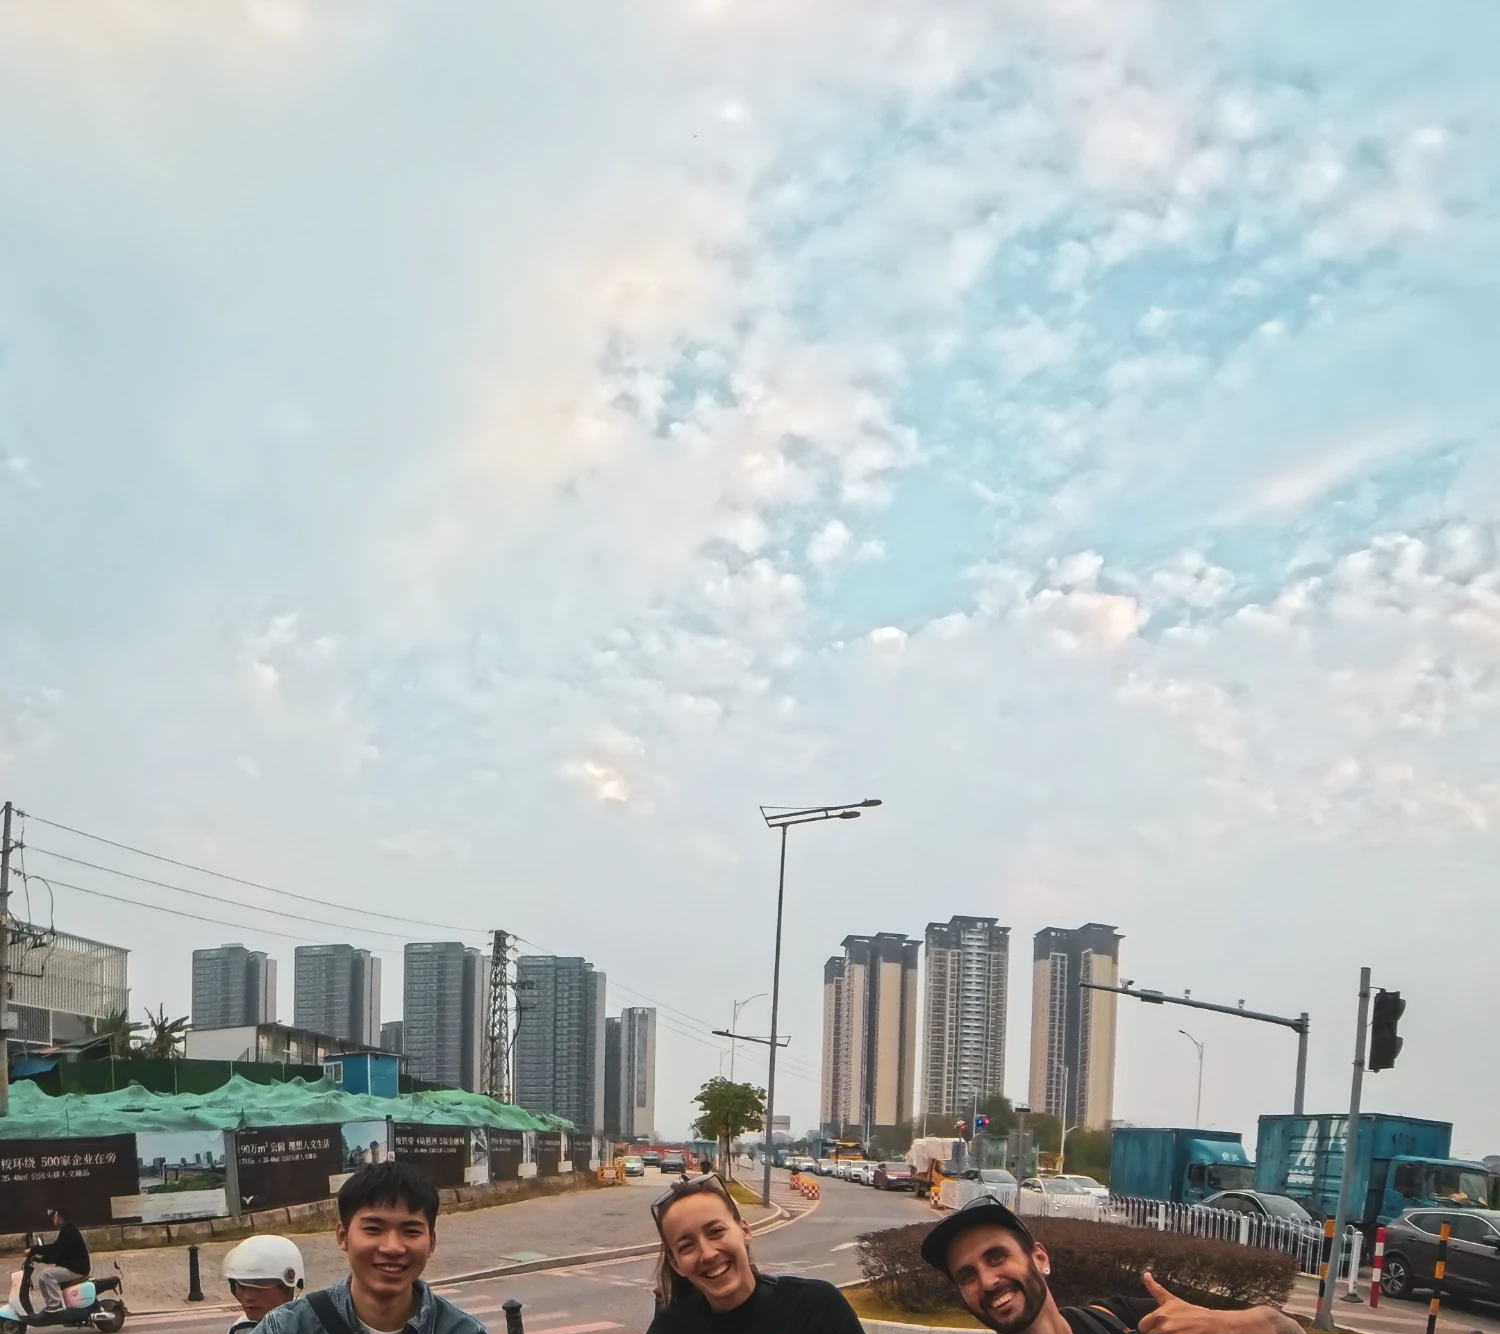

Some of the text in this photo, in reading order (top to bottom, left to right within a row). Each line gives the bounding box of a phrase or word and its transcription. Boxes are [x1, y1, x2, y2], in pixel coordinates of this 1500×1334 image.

[270, 1142, 285, 1152] 公园
[41, 1152, 117, 1168] 500家企业在旁
